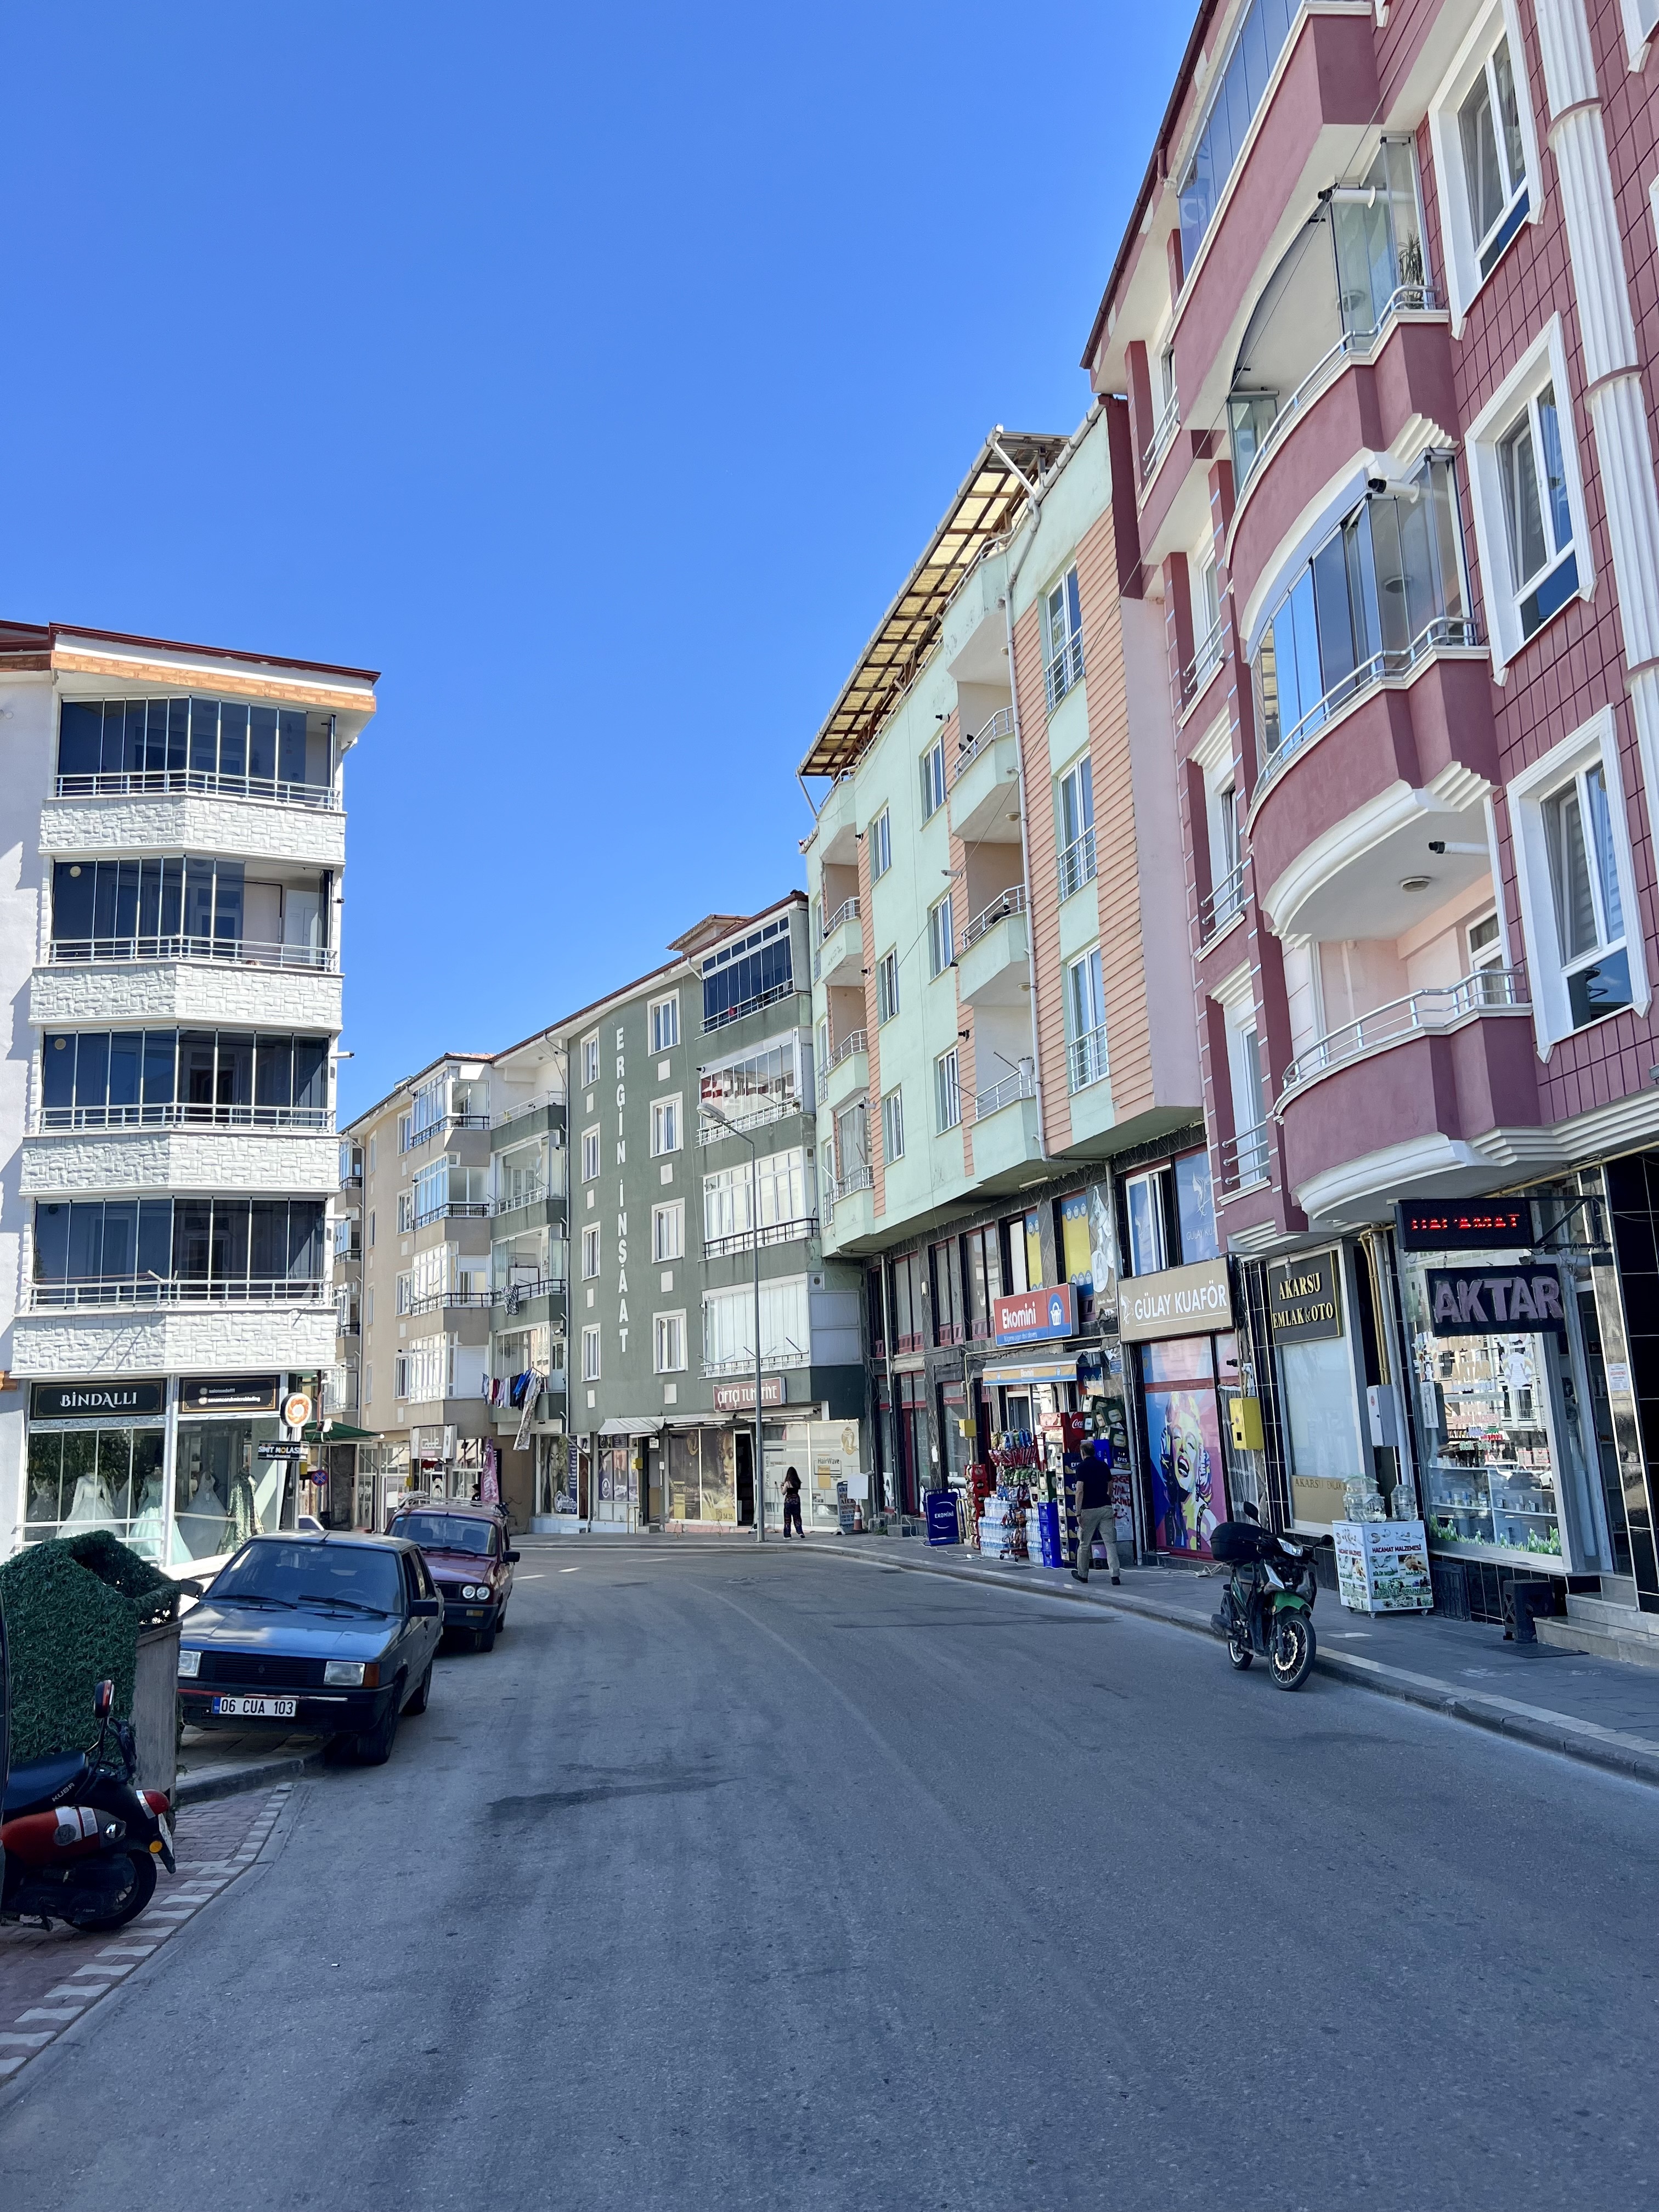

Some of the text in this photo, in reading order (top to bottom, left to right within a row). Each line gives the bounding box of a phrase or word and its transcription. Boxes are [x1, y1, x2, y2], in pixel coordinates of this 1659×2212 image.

[616, 1027, 629, 1352] ERGİN İNŞAAT
[1279, 1272, 1321, 1300] AKARSU
[1134, 1279, 1227, 1321] GÜLAY KUAFÖR
[1433, 1276, 1564, 1323] AKTAR
[1002, 1301, 1036, 1329] Ekomini
[60, 1391, 137, 1408] BİNDALLI
[718, 1386, 740, 1409] ÇİFTÇİ
[934, 1510, 954, 1519] EKOMİNİ
[221, 1699, 236, 1713] 06
[243, 1700, 264, 1714] CUA
[274, 1701, 294, 1715] 103
[52, 1782, 75, 1802] KUBA
